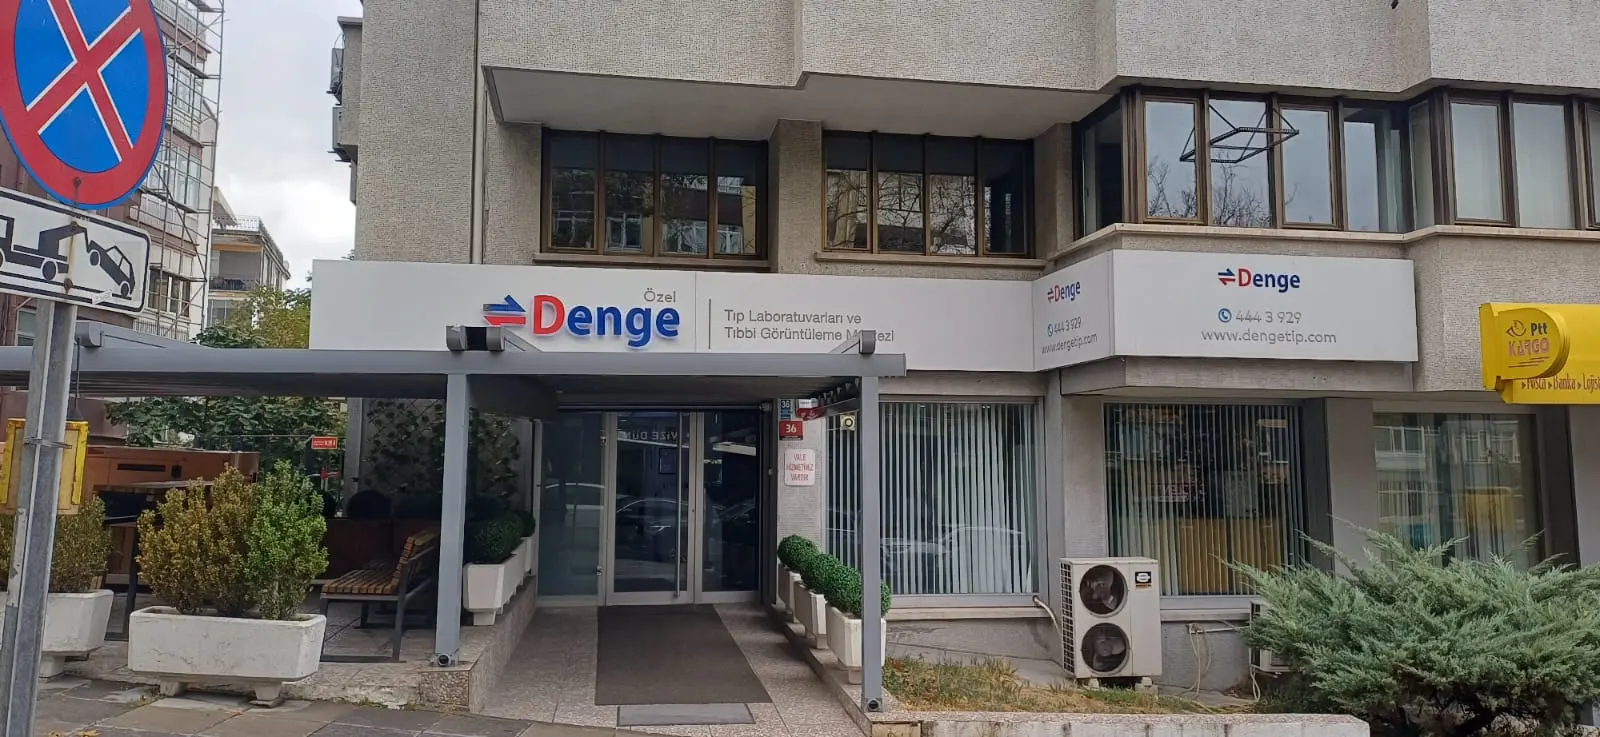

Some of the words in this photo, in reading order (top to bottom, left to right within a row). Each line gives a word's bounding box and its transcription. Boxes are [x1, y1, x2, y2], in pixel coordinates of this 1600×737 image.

[1238, 268, 1301, 293] Denge
[643, 287, 677, 303] Özel
[1054, 281, 1081, 302] Denge
[533, 294, 681, 348] Denge
[724, 309, 745, 324] Tıp
[749, 310, 843, 324] Laboratuvarları
[846, 314, 862, 324] ve
[1236, 310, 1262, 323] 444
[1265, 311, 1273, 323] 3
[1277, 311, 1302, 324] 929
[760, 327, 842, 341] Görüntüleme
[1201, 328, 1337, 345] www.dengetip.com
[1530, 322, 1548, 336] Ptt
[781, 400, 790, 409] 36
[785, 424, 797, 433] 36
